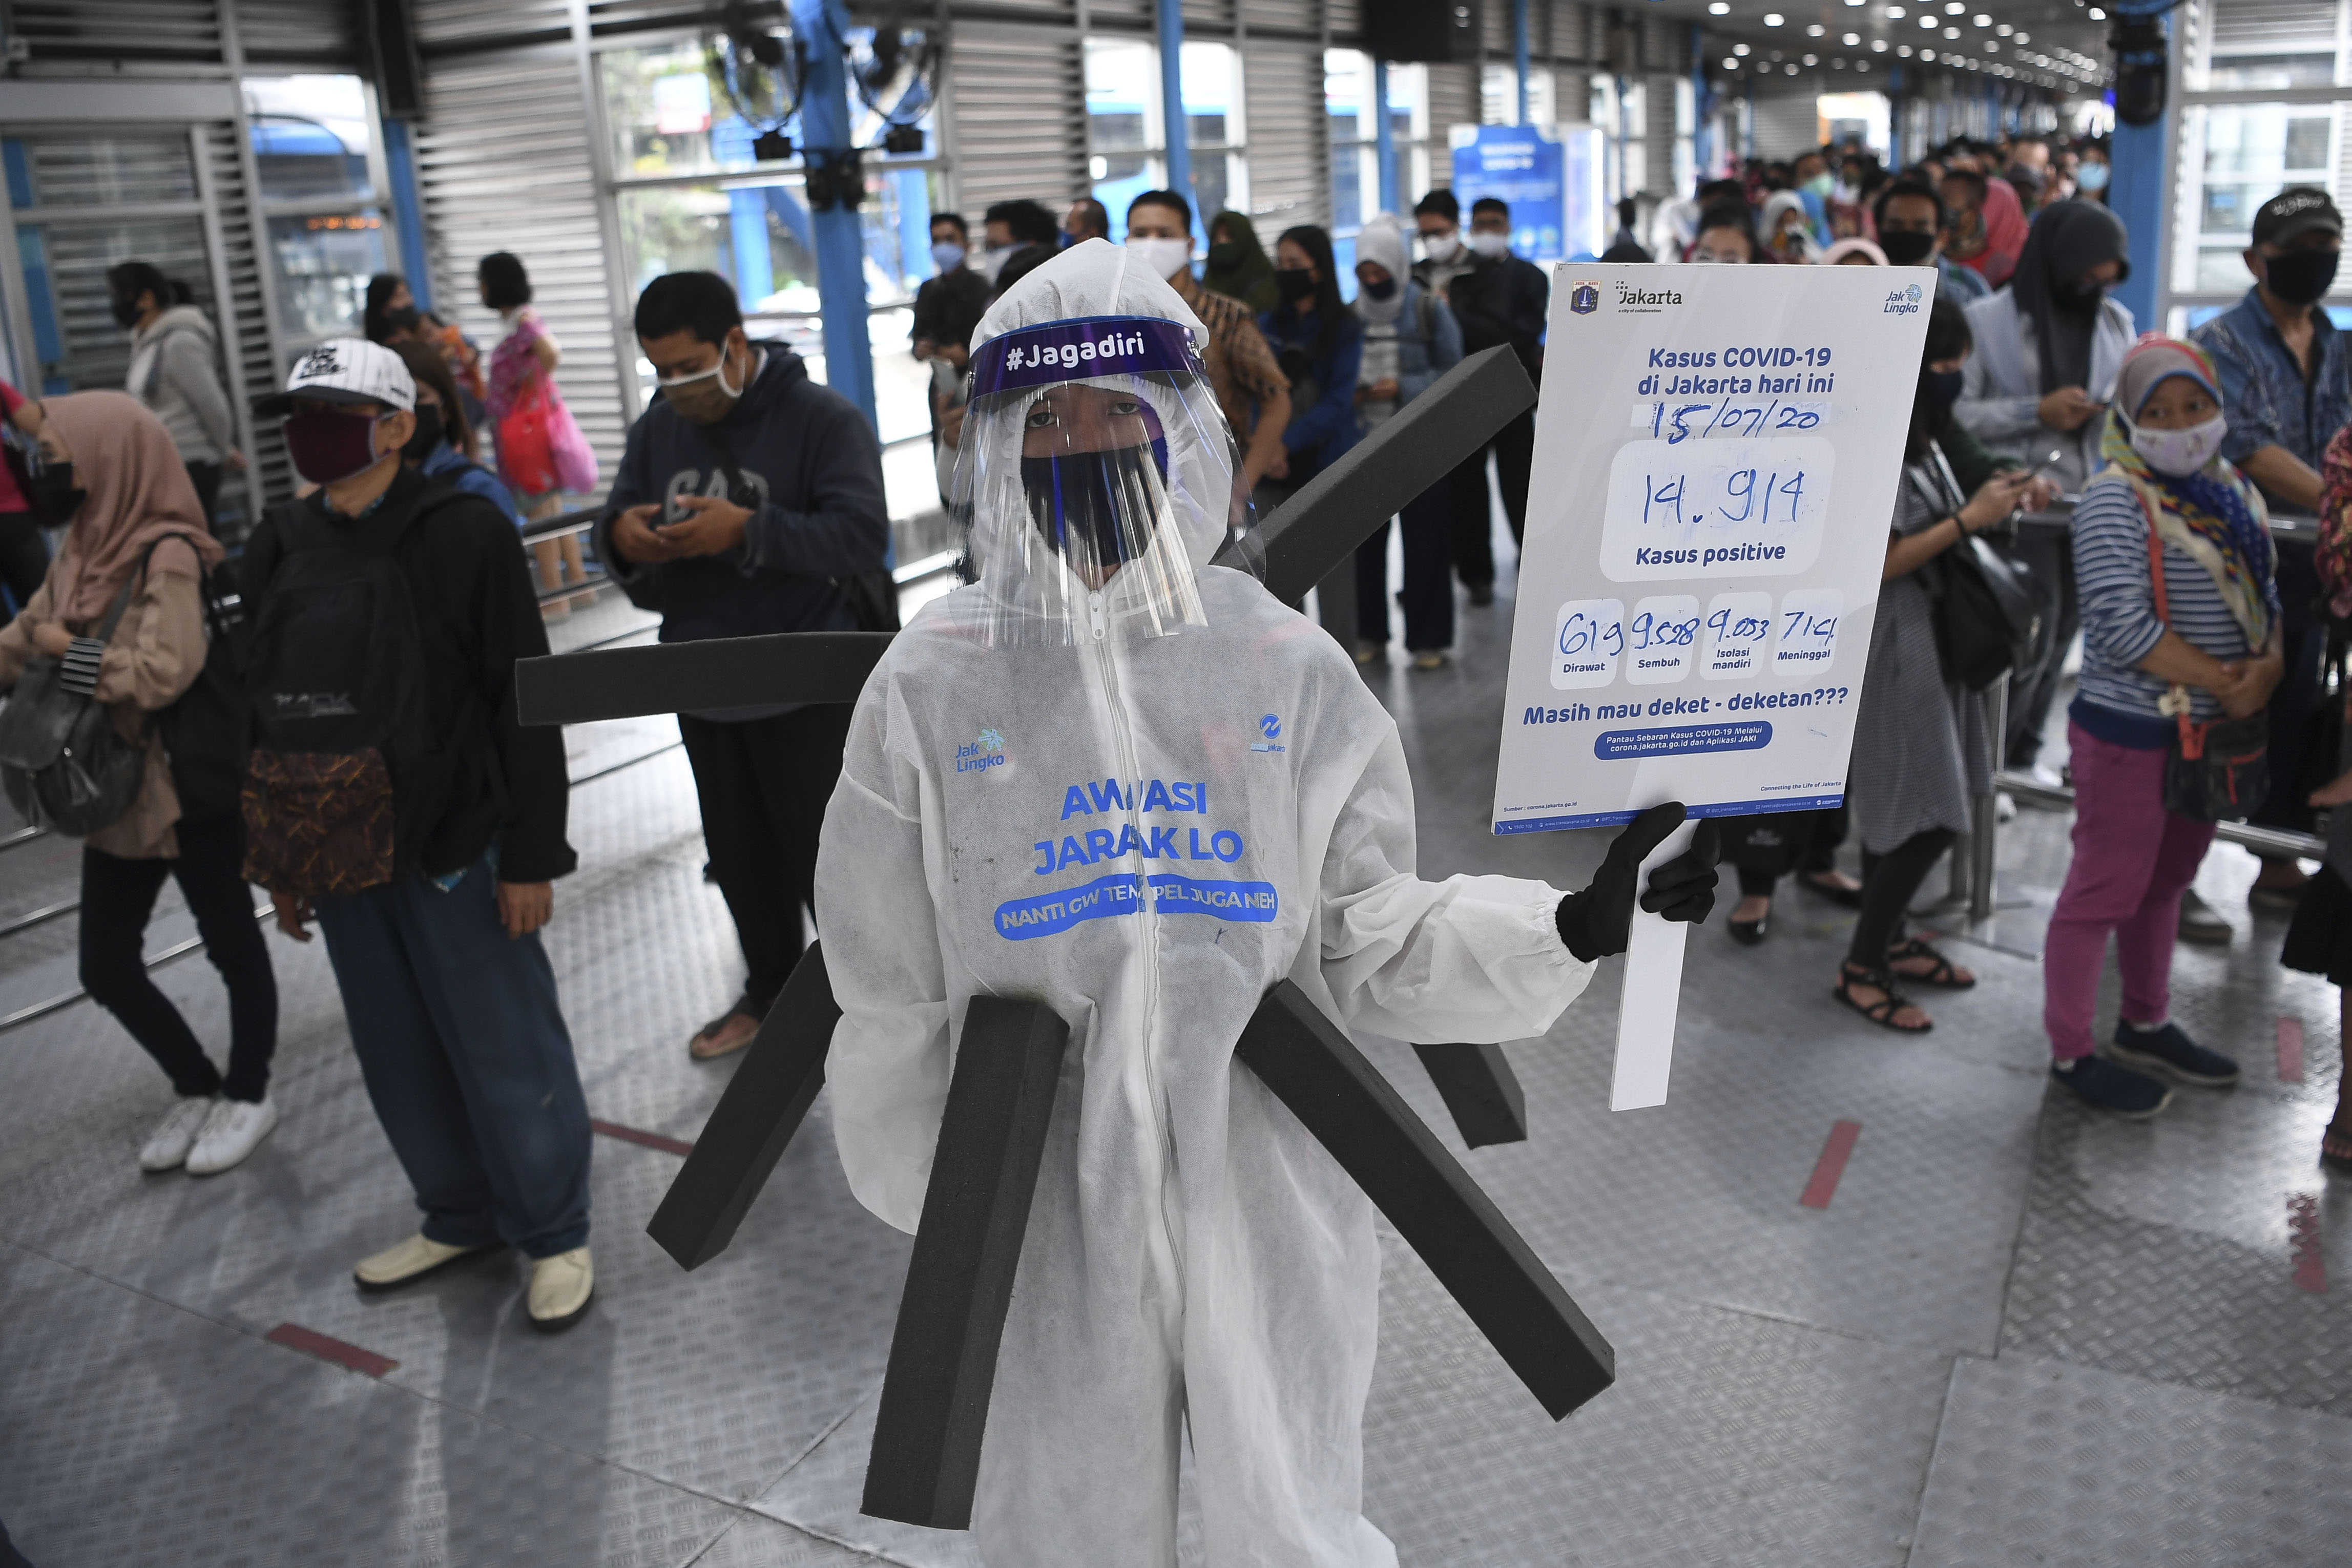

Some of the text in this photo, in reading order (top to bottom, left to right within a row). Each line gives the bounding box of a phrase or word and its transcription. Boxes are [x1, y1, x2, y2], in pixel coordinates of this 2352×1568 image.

[1619, 288, 1683, 305] Jakarta
[1885, 290, 1905, 302] Jak
[1883, 302, 1919, 316] Lingko
[1006, 331, 1145, 371] #Jagadiri
[1648, 347, 1832, 368] Kasus COVID-19
[1638, 372, 1834, 395] di Jakarta hari ini
[1653, 397, 1821, 445] 15/07/20
[1635, 541, 1786, 567] Kasus positive
[1559, 613, 1624, 656] 619
[1717, 647, 1750, 658] Isolasi
[1777, 649, 1831, 661] Meninggal
[1563, 662, 1606, 673] Dirawat
[1637, 657, 1680, 668] Sembuh
[1712, 658, 1751, 670] mandiri
[1523, 703, 1591, 725] Masih
[1596, 704, 1642, 720] mau
[1648, 696, 1711, 717] deket
[1727, 687, 1849, 712] deketan???
[1606, 726, 1763, 744] Pantau Sebaran Kasus COVID-19 Melalui
[1610, 739, 1689, 752] corona.jakarta.go.id
[1705, 736, 1737, 747] Aplikasi
[1738, 735, 1757, 743] JAKI
[955, 742, 980, 759] Jak
[956, 754, 1005, 772] Lingko
[1060, 778, 1207, 821] AWASI
[1527, 801, 1577, 810] corona.jakarta.go.id
[1034, 823, 1244, 875] JARAK LO
[1001, 902, 1066, 930] NANTI
[1069, 888, 1100, 914] GW
[1190, 887, 1243, 909] JUGA
[1245, 892, 1276, 910] NEH
